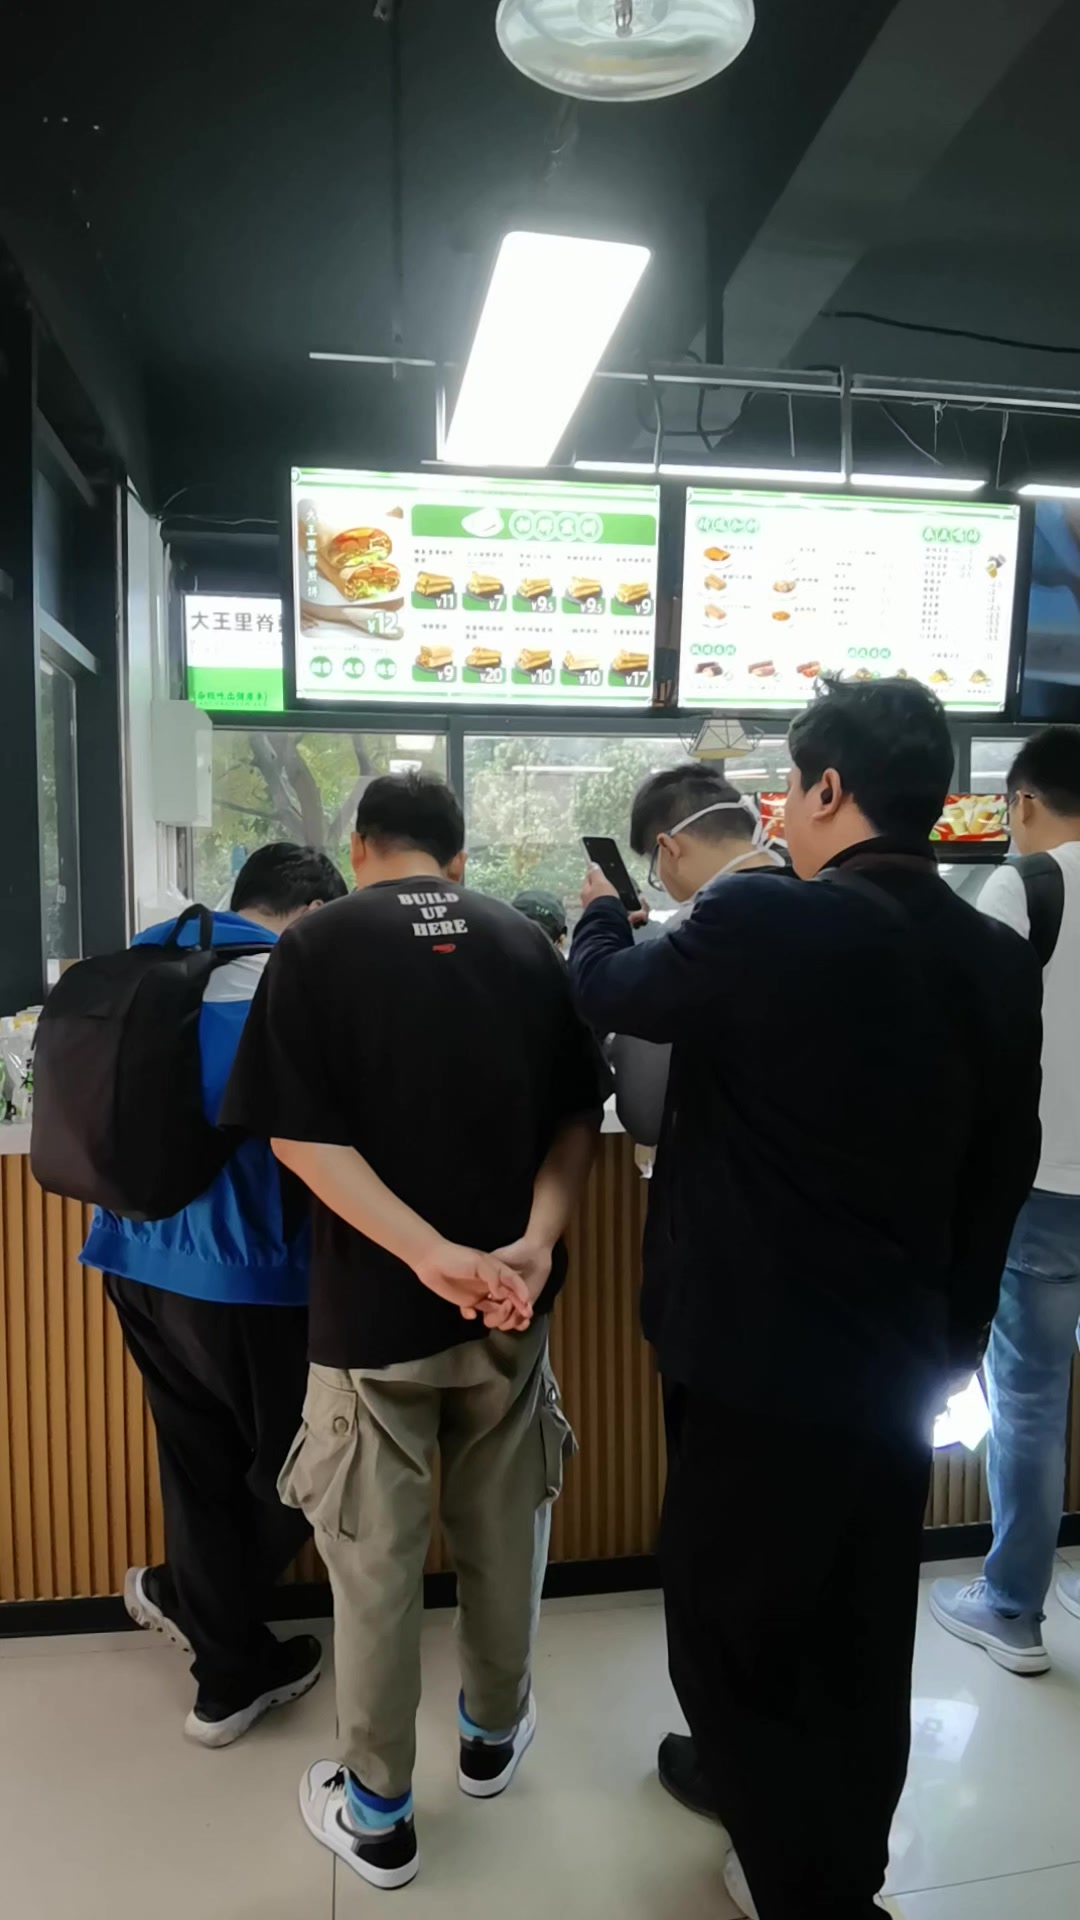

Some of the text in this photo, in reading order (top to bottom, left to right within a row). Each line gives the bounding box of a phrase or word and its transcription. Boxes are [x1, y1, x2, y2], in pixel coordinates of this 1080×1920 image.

[191, 611, 282, 633] 大王里脊
[397, 892, 460, 905] BUILD
[420, 905, 448, 920] UP
[411, 918, 469, 937] HERE
